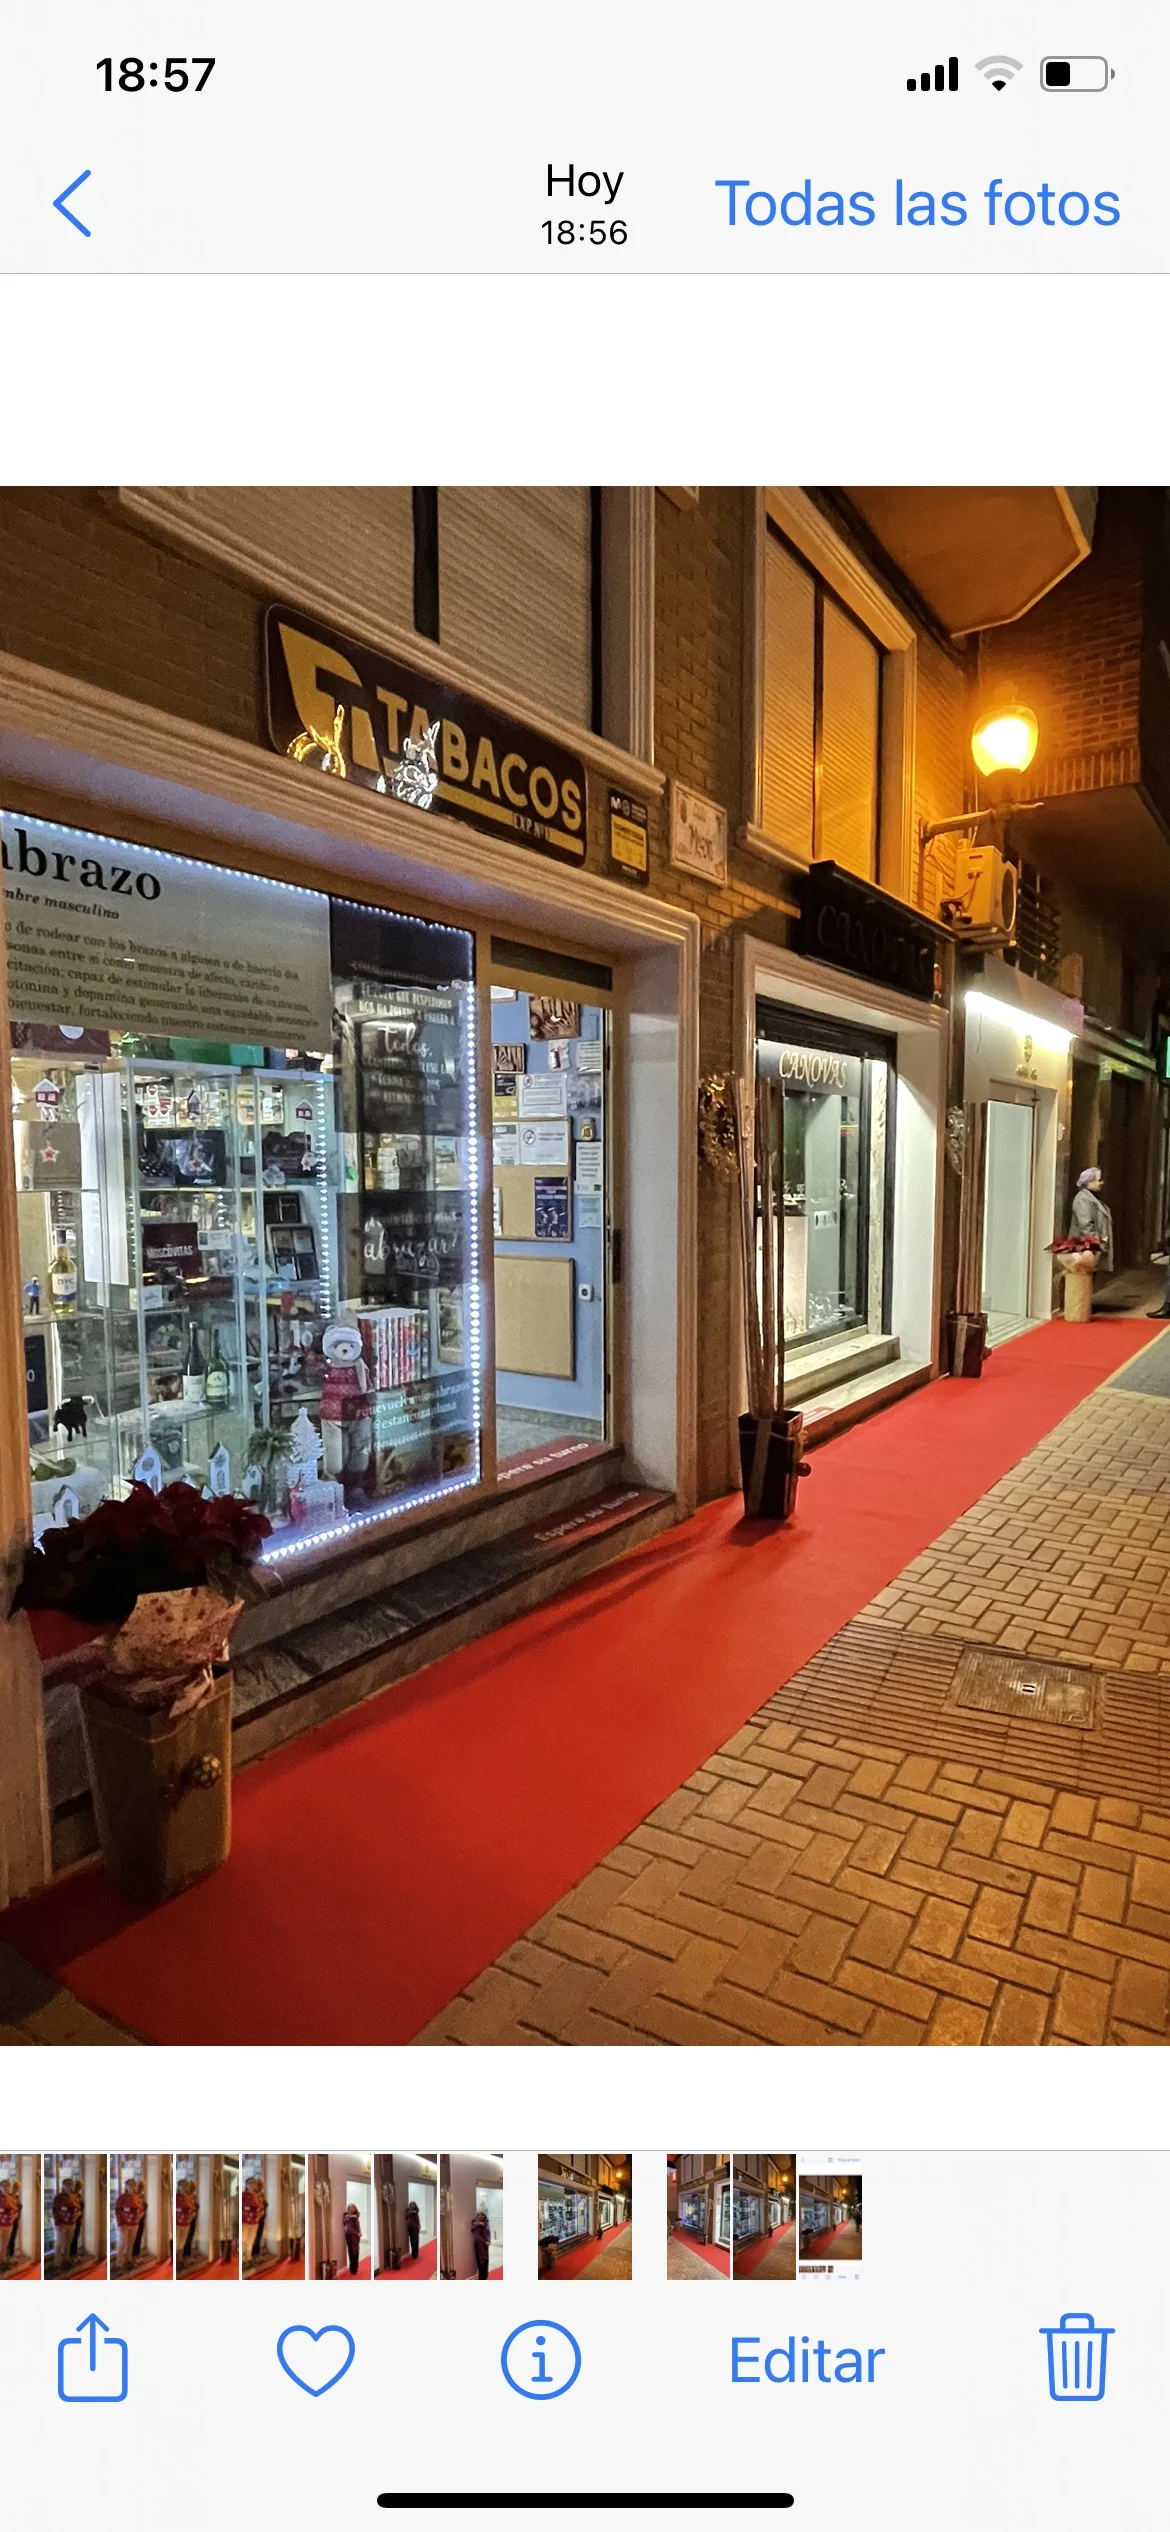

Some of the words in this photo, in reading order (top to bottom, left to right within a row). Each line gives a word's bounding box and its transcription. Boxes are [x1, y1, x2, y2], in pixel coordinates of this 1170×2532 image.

[377, 686, 586, 833] TABACOS
[45, 896, 120, 919] masculino
[16, 920, 33, 936] de
[36, 927, 81, 943] rodear
[83, 936, 106, 947] con
[108, 935, 127, 951] los
[128, 939, 167, 956] brazos
[170, 950, 178, 961] a
[49, 948, 85, 961] entre
[67, 968, 104, 983] capaz
[107, 972, 123, 984] de
[126, 978, 182, 993] estimular
[62, 987, 70, 998] y
[73, 985, 135, 1004] dopamina
[139, 997, 198, 1012] generando
[78, 1003, 158, 1024] fortaleciendo
[160, 1016, 204, 1029] nuestro
[779, 1050, 848, 1089] CANOVAS
[532, 1456, 553, 1465] su
[549, 1442, 589, 1458] turno
[533, 1516, 586, 1541] Espere
[600, 1491, 640, 1509] turno
